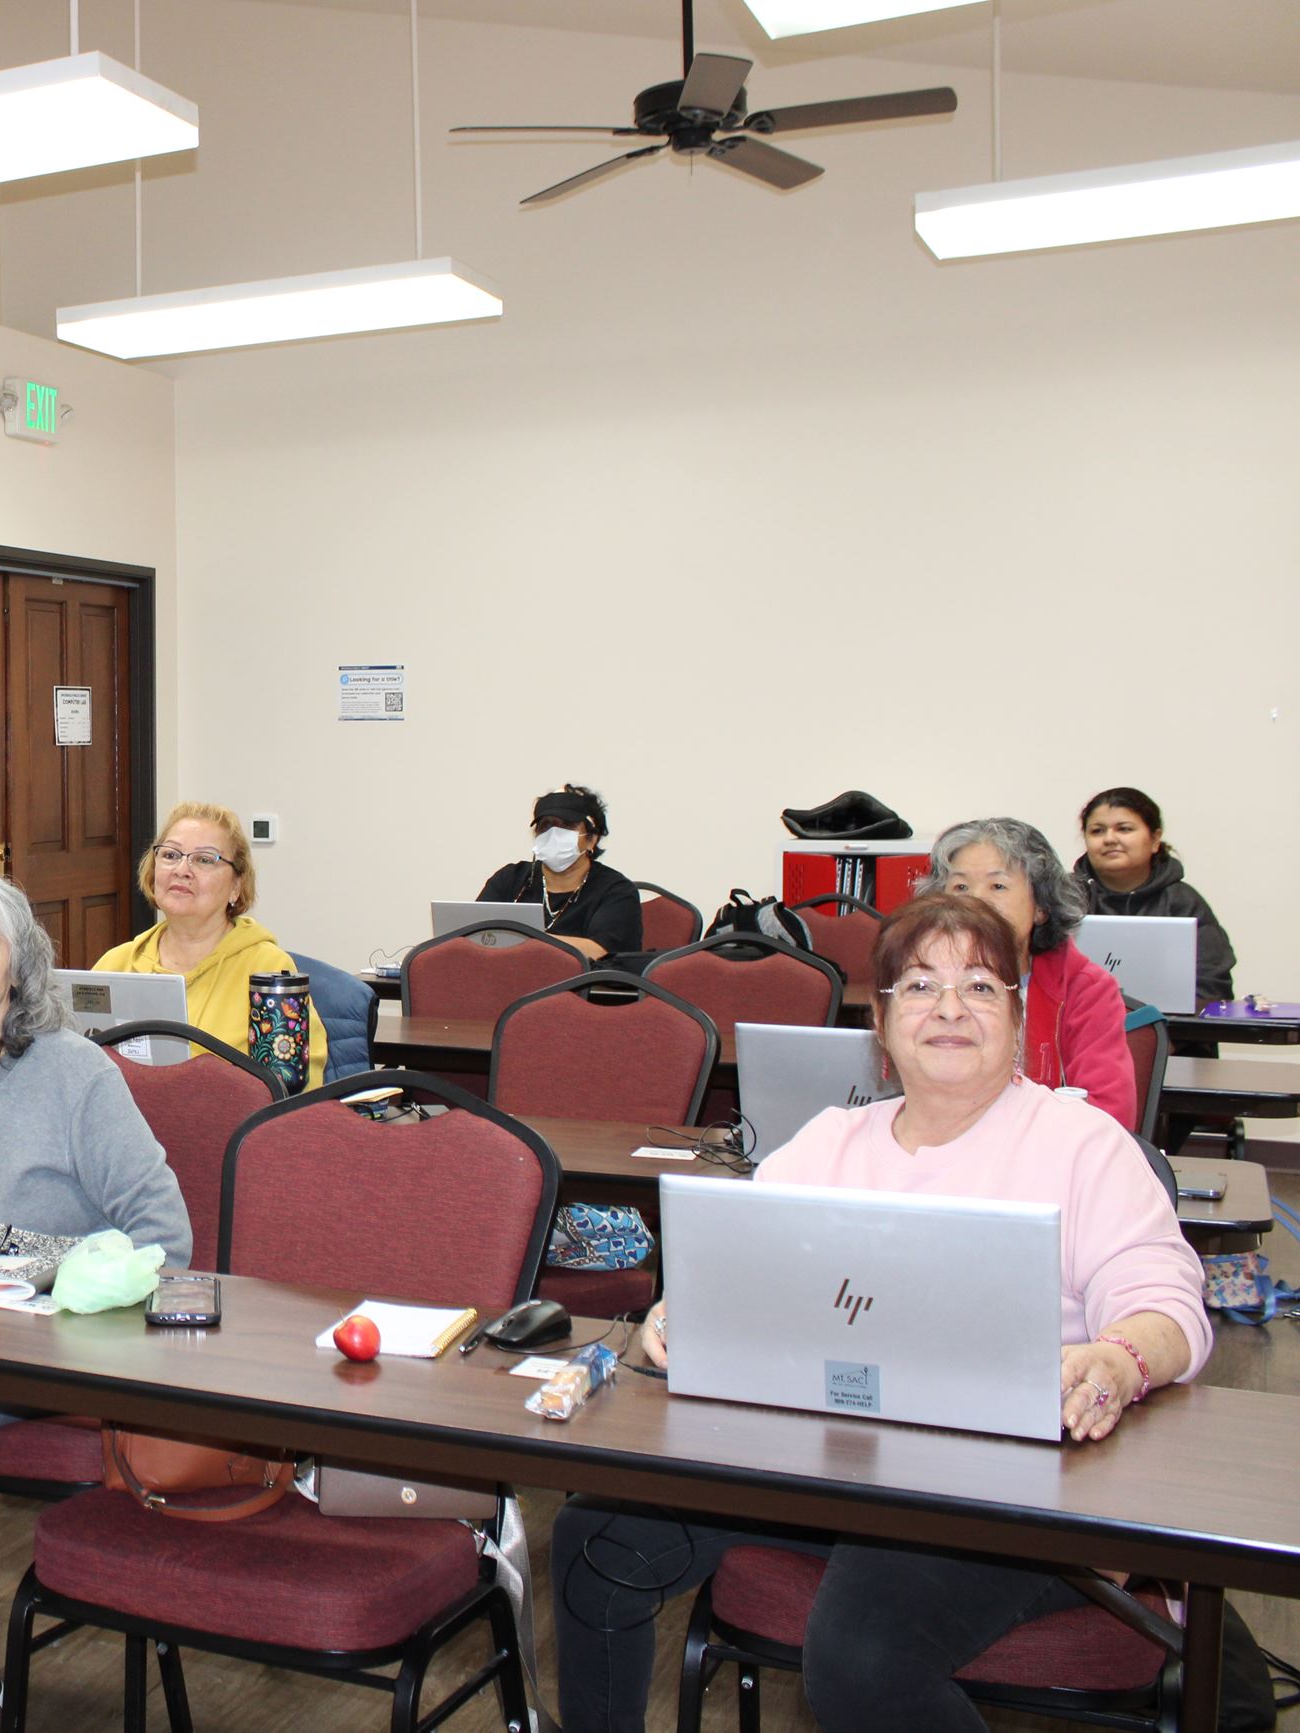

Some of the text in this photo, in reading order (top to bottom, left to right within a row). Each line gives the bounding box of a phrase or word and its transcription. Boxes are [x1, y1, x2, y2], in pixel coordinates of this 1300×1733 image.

[26, 381, 57, 433] EXIT
[1104, 951, 1122, 972] hp
[833, 1278, 874, 1326] hp
[847, 1375, 864, 1384] SAC
